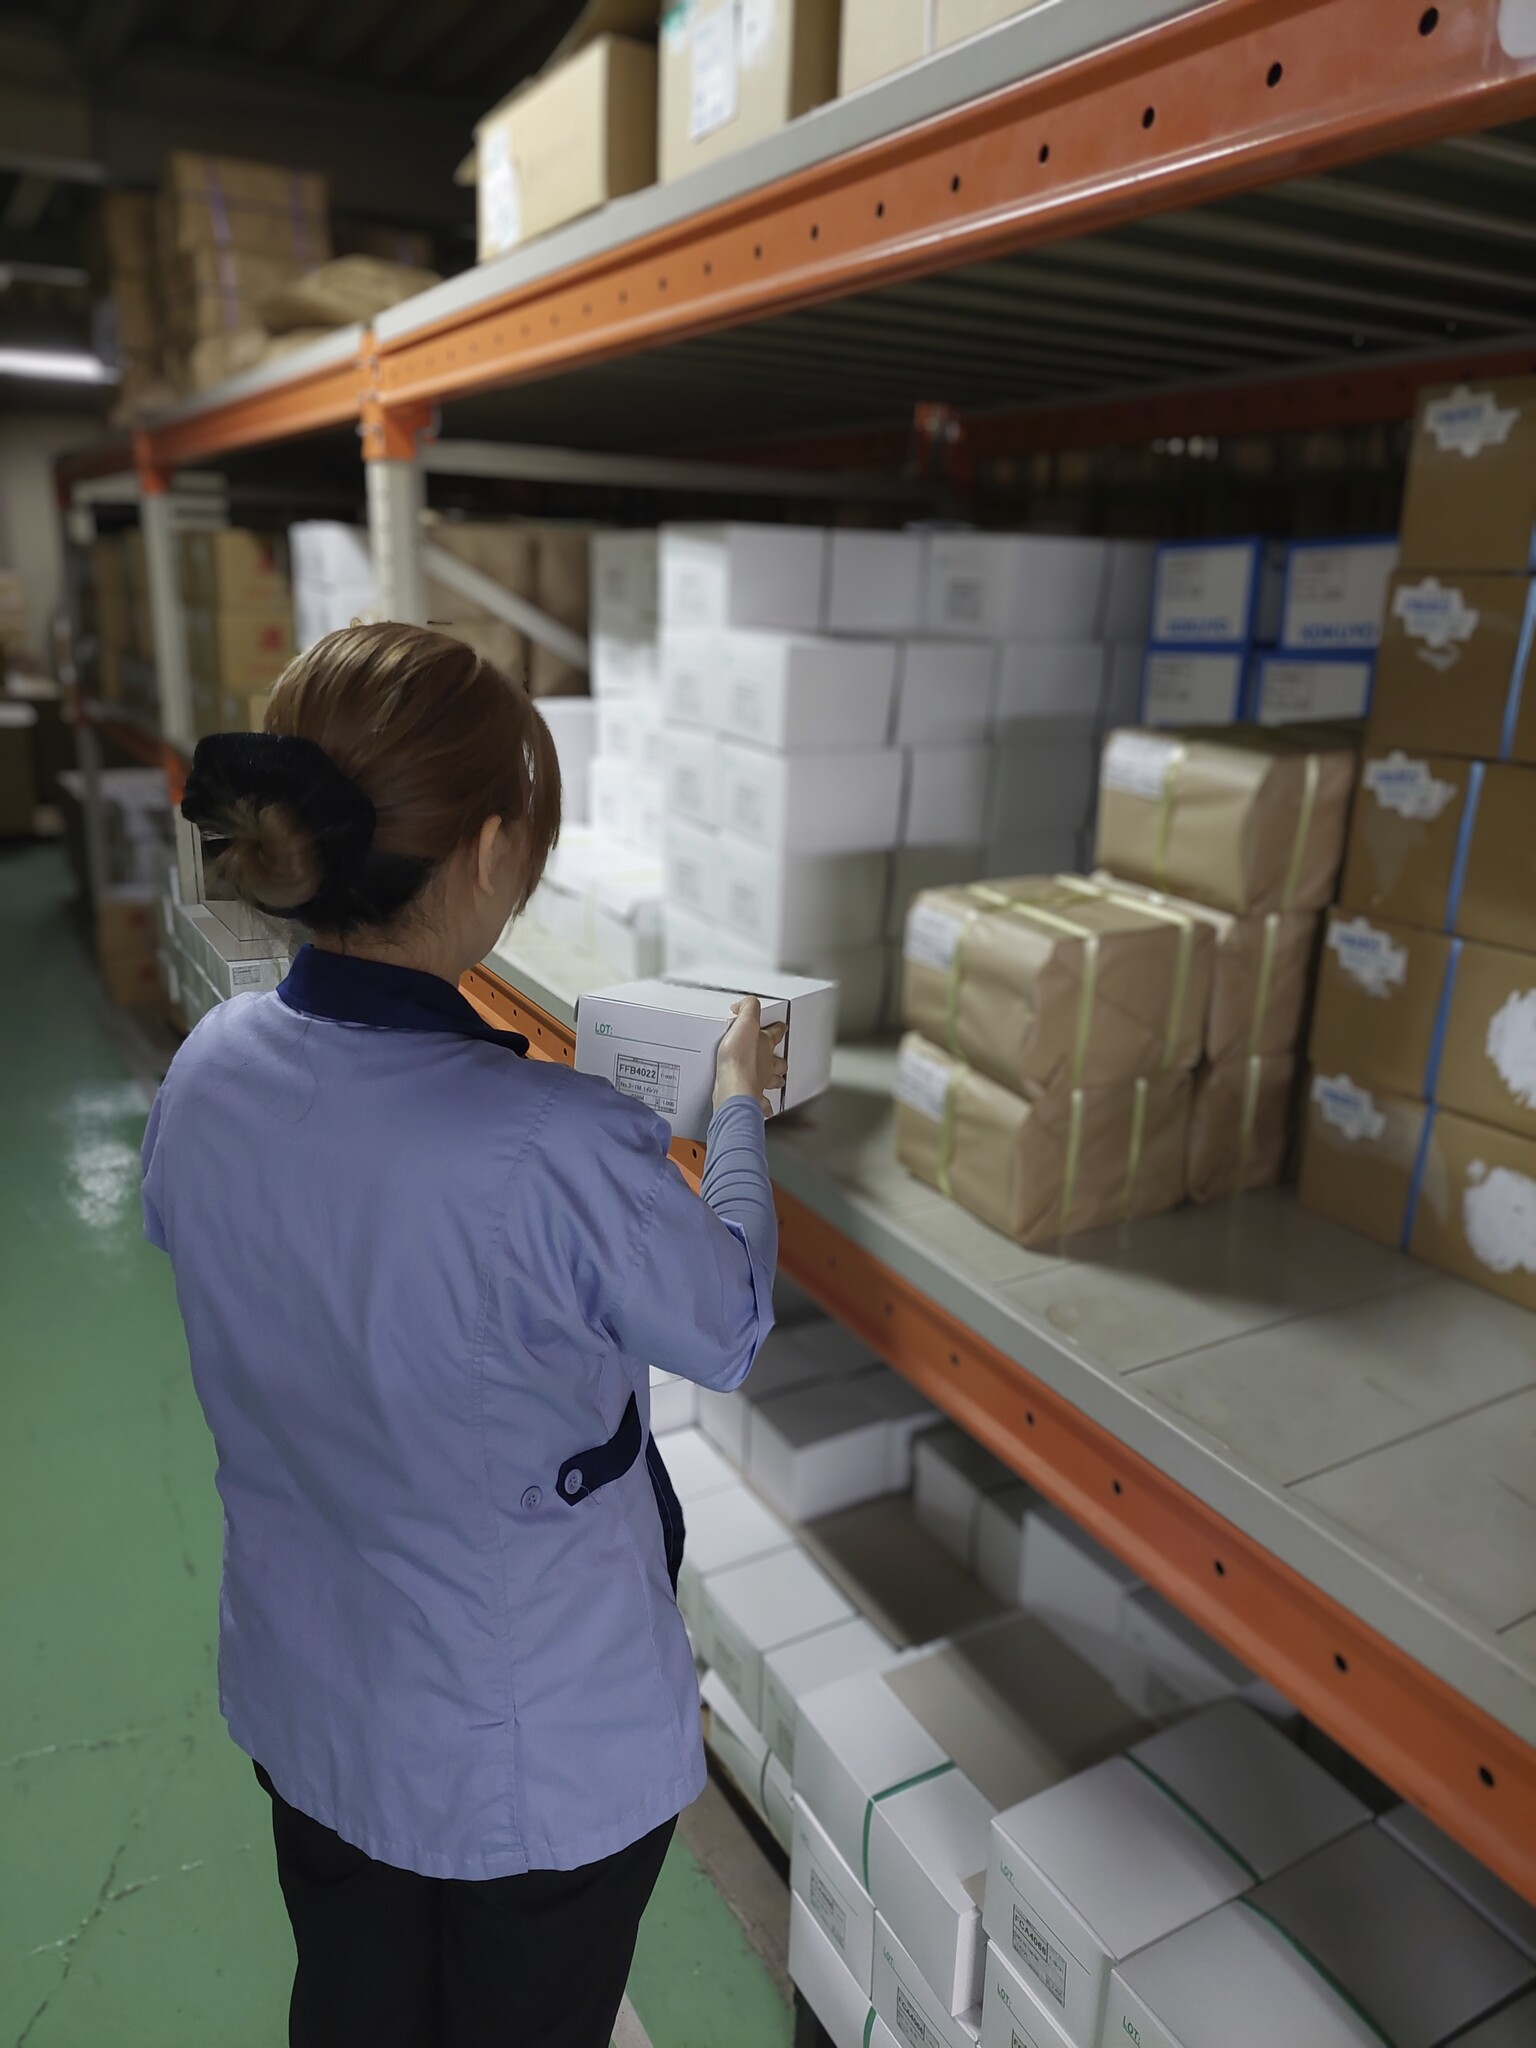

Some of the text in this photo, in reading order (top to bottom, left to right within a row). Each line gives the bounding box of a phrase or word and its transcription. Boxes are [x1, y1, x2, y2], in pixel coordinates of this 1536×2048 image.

[595, 1022, 613, 1035] LOT:
[619, 1064, 657, 1079] FFB4022
[1122, 2015, 1141, 2045] LOT:
